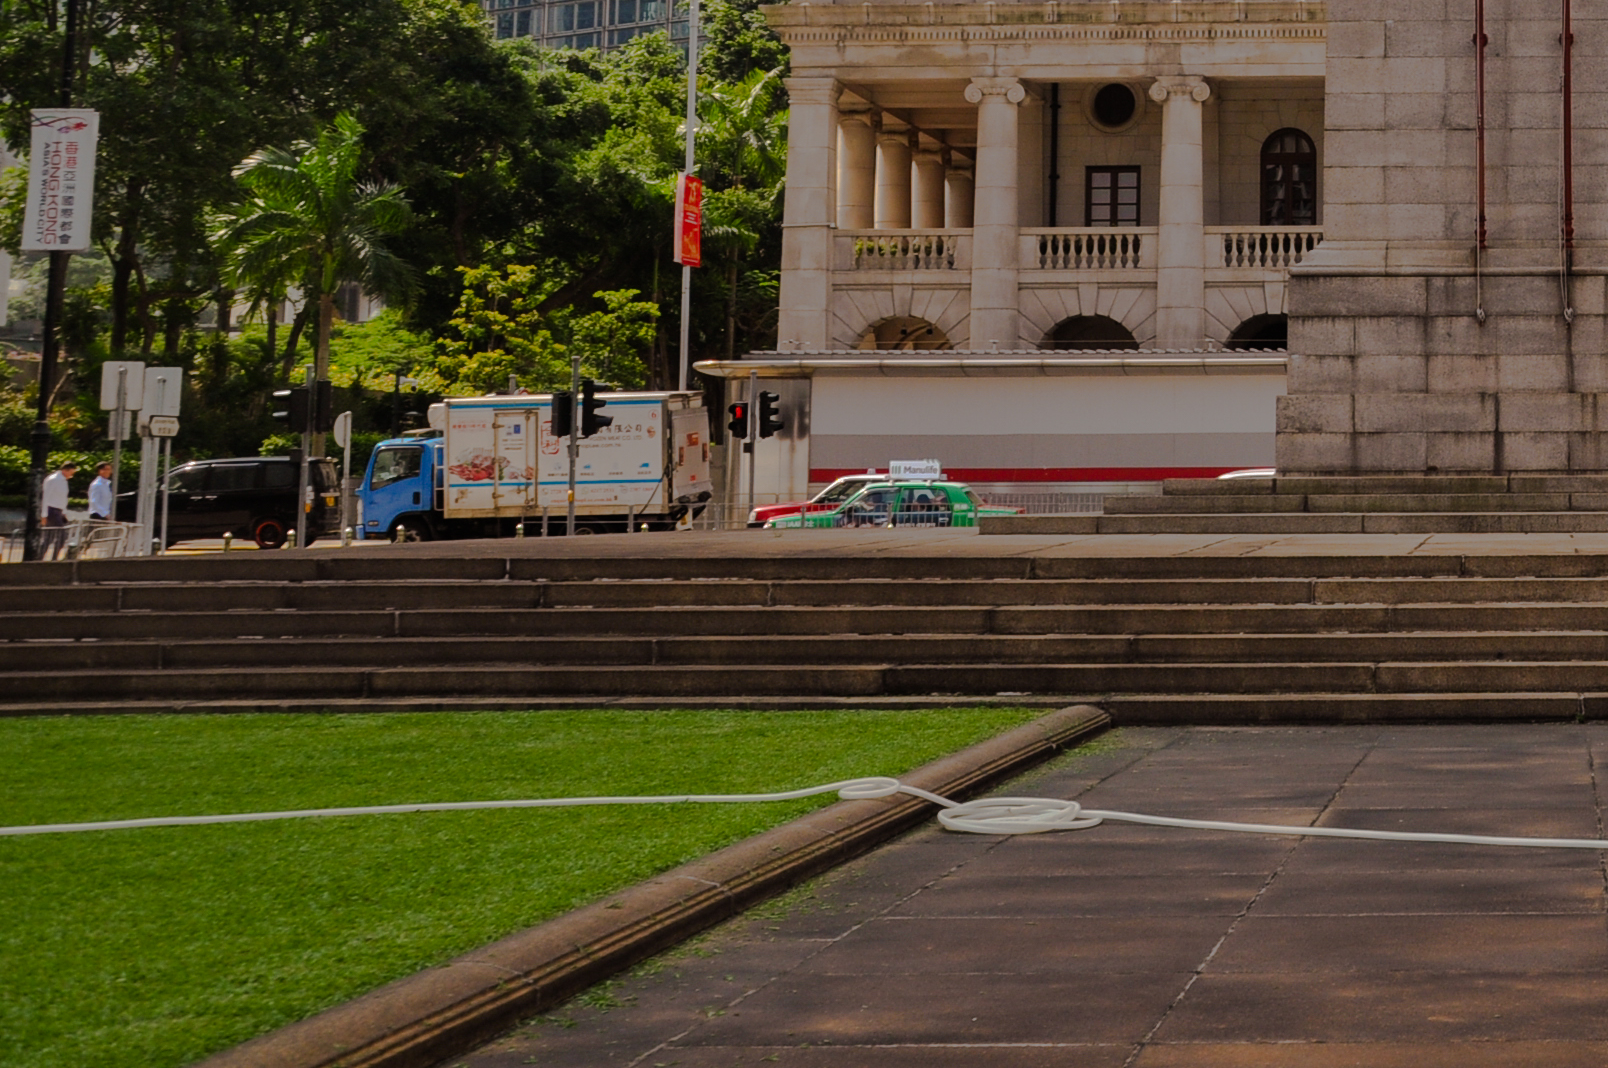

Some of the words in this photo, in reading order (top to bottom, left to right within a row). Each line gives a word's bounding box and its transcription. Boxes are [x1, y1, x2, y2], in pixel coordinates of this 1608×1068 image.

[48, 141, 63, 193] HONG
[38, 177, 49, 217] WORLD
[34, 218, 45, 244] CITY
[43, 194, 59, 245] KONG
[902, 465, 938, 475] Manulife
